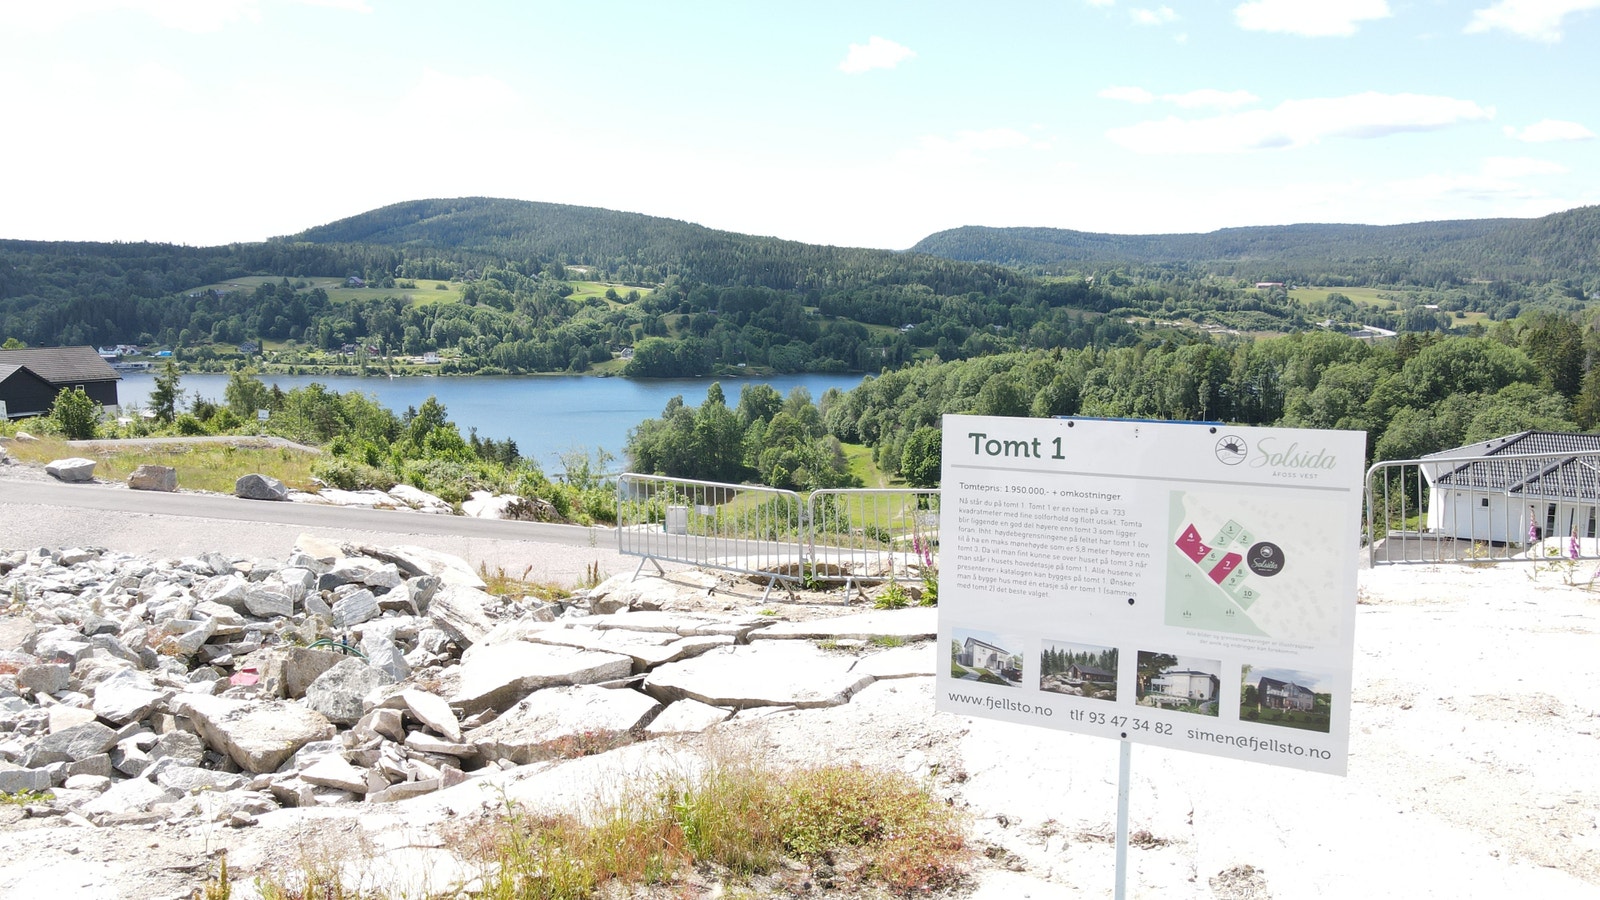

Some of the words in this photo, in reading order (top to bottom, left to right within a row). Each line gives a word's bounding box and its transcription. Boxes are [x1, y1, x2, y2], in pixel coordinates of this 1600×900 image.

[968, 432, 1041, 458] Tomt
[1052, 436, 1066, 460] 1
[1249, 436, 1336, 470] Solsida
[1272, 470, 1297, 478] ÅFOSS
[959, 482, 1002, 494] Tomtepris:
[1060, 490, 1123, 502] omkostninger.
[959, 507, 1002, 517] kvadratmeter
[1034, 513, 1068, 522] solforhold
[1120, 519, 1143, 528] Tomta
[994, 500, 1002, 509] på
[1090, 507, 1099, 516] på
[971, 517, 998, 526] liggende
[1036, 522, 1059, 532] høyere
[1116, 529, 1137, 538] ligger
[995, 529, 1068, 542] høydebegrensningene
[1069, 534, 1078, 543] på
[1080, 536, 1098, 544] feltet
[1010, 541, 1048, 550] mønehøyde
[1111, 548, 1134, 558] høyere
[1030, 551, 1051, 559] kunne
[1079, 555, 1098, 564] huset
[1100, 557, 1108, 566] på
[1135, 560, 1148, 568] når
[957, 564, 995, 573] presenterer
[1000, 567, 1032, 578] katalogen
[1048, 572, 1071, 582] bygges
[1073, 574, 1082, 583] på
[1110, 578, 1135, 587] Ønsker
[991, 557, 1013, 565] husets
[1015, 559, 1054, 570] hovedetasje
[1056, 562, 1064, 572] på
[1107, 568, 1133, 577] husene
[978, 574, 996, 584] bygge
[1038, 581, 1059, 590] etasje
[1008, 587, 1026, 595] beste
[948, 692, 1052, 716] www.fjellsto.no
[1070, 710, 1084, 721] tlf
[1089, 712, 1106, 724] 93
[1110, 716, 1128, 728] 47
[1132, 718, 1150, 733] 34
[1154, 722, 1173, 736] 82
[1188, 728, 1331, 760] simen@fjellsto.no
